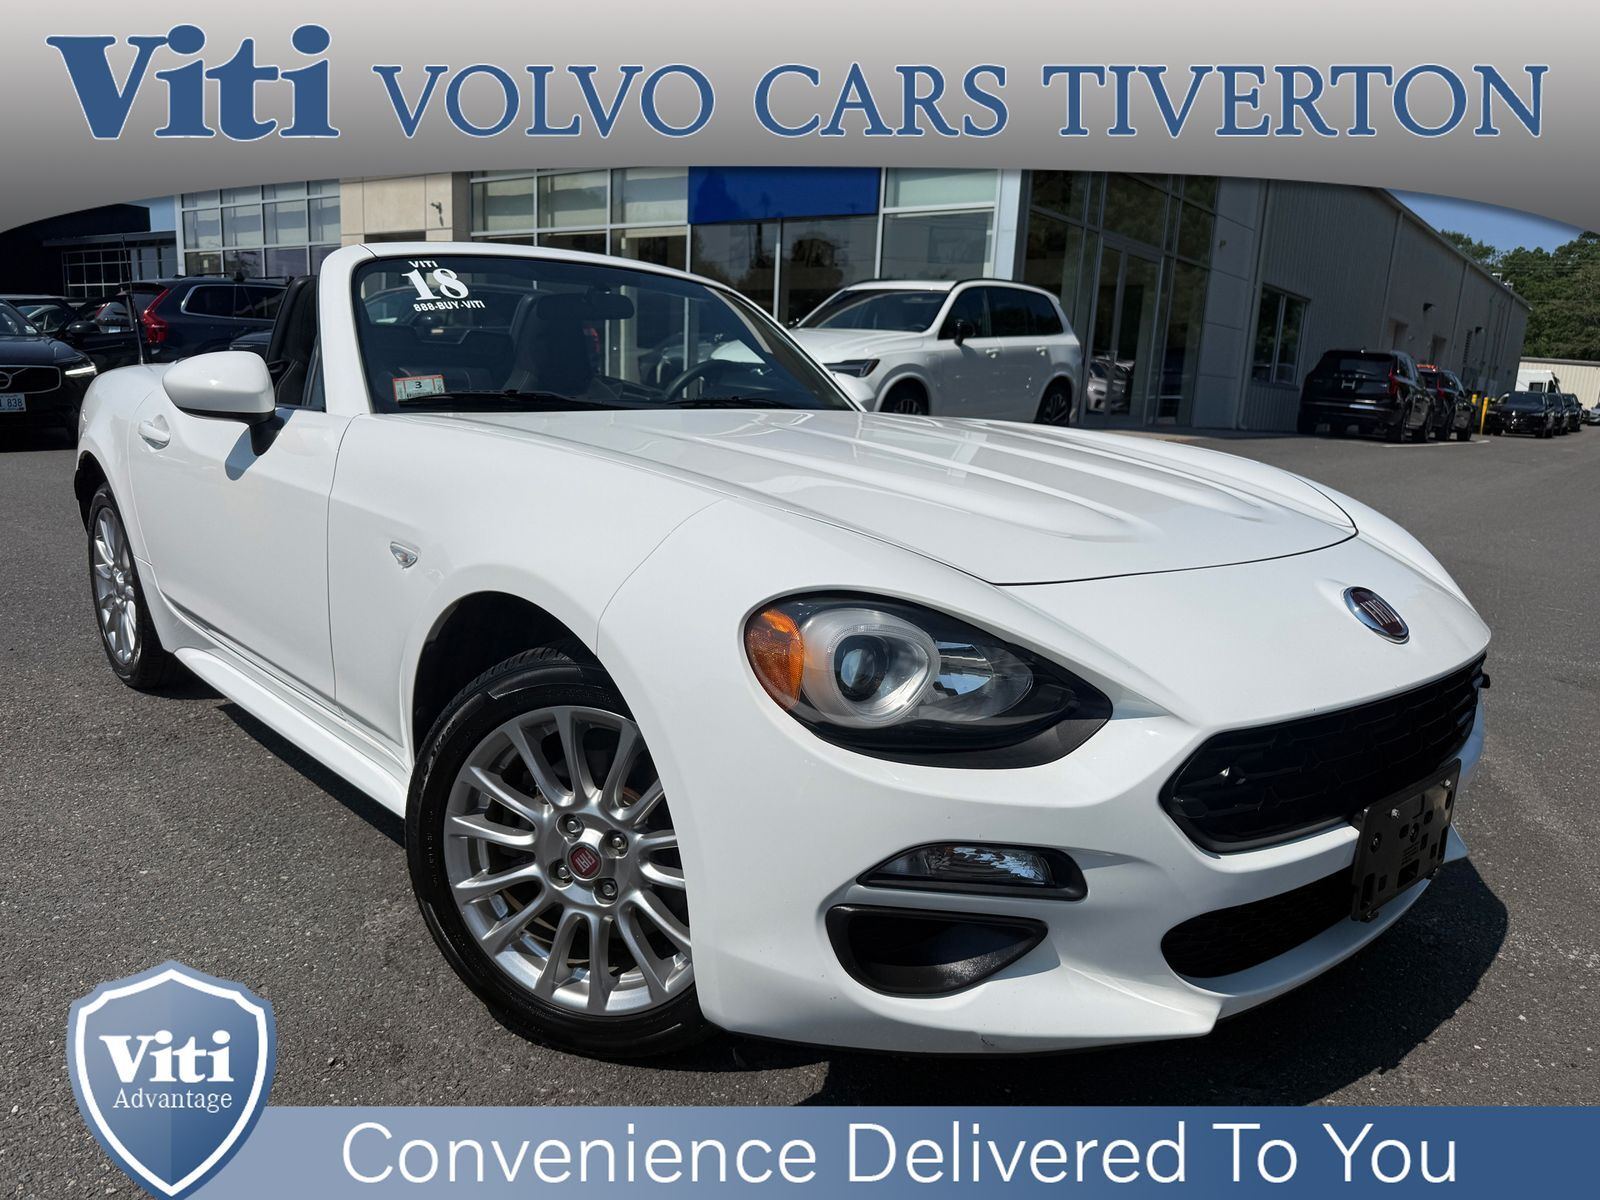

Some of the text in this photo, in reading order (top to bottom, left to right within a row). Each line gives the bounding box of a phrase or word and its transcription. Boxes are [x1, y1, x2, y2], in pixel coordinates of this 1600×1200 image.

[408, 260, 439, 268] VITI
[401, 268, 469, 300] 18
[413, 300, 486, 312] 888-BUY-VITI
[415, 381, 423, 389] 3
[574, 849, 597, 874] FIAT
